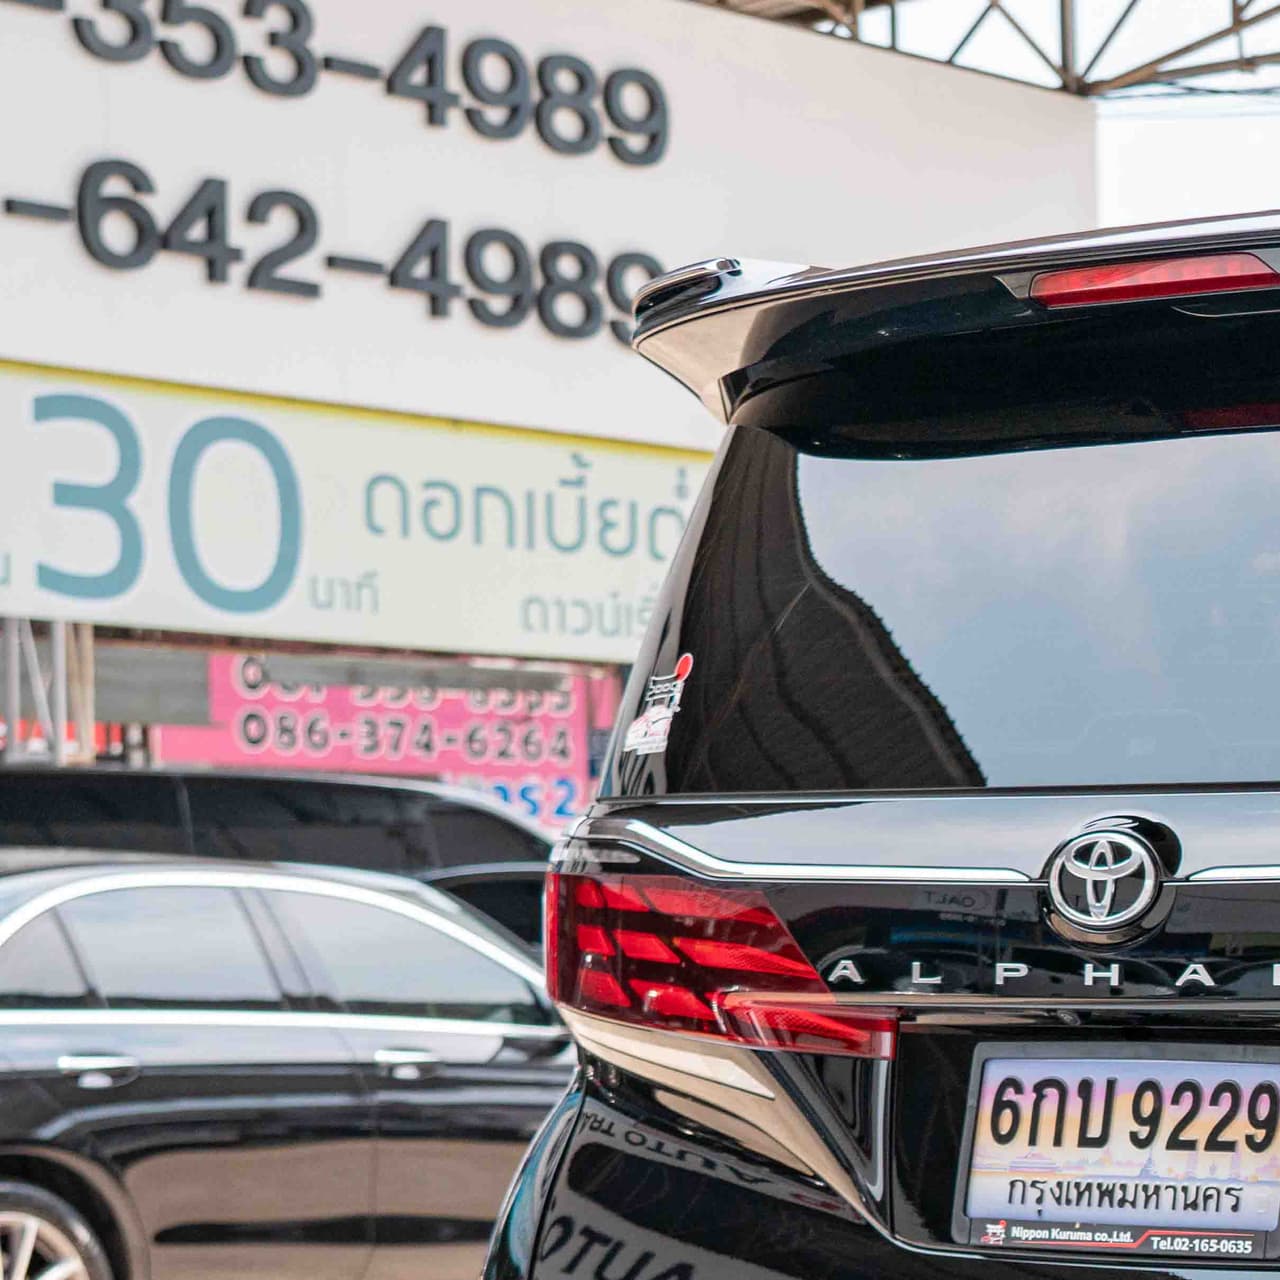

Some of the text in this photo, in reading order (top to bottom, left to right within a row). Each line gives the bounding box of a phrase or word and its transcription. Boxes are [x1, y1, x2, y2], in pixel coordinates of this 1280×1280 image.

[32, 393, 303, 614] 30
[242, 713, 571, 760] 086-374-6264
[1127, 1078, 1280, 1153] 9229
[1007, 1178, 1243, 1217] กรุงเทพมหานคร
[1011, 1226, 1050, 1242] Nippon
[1051, 1228, 1093, 1242] Kuruma
[1150, 1236, 1253, 1254] Tel.02-165-0635
